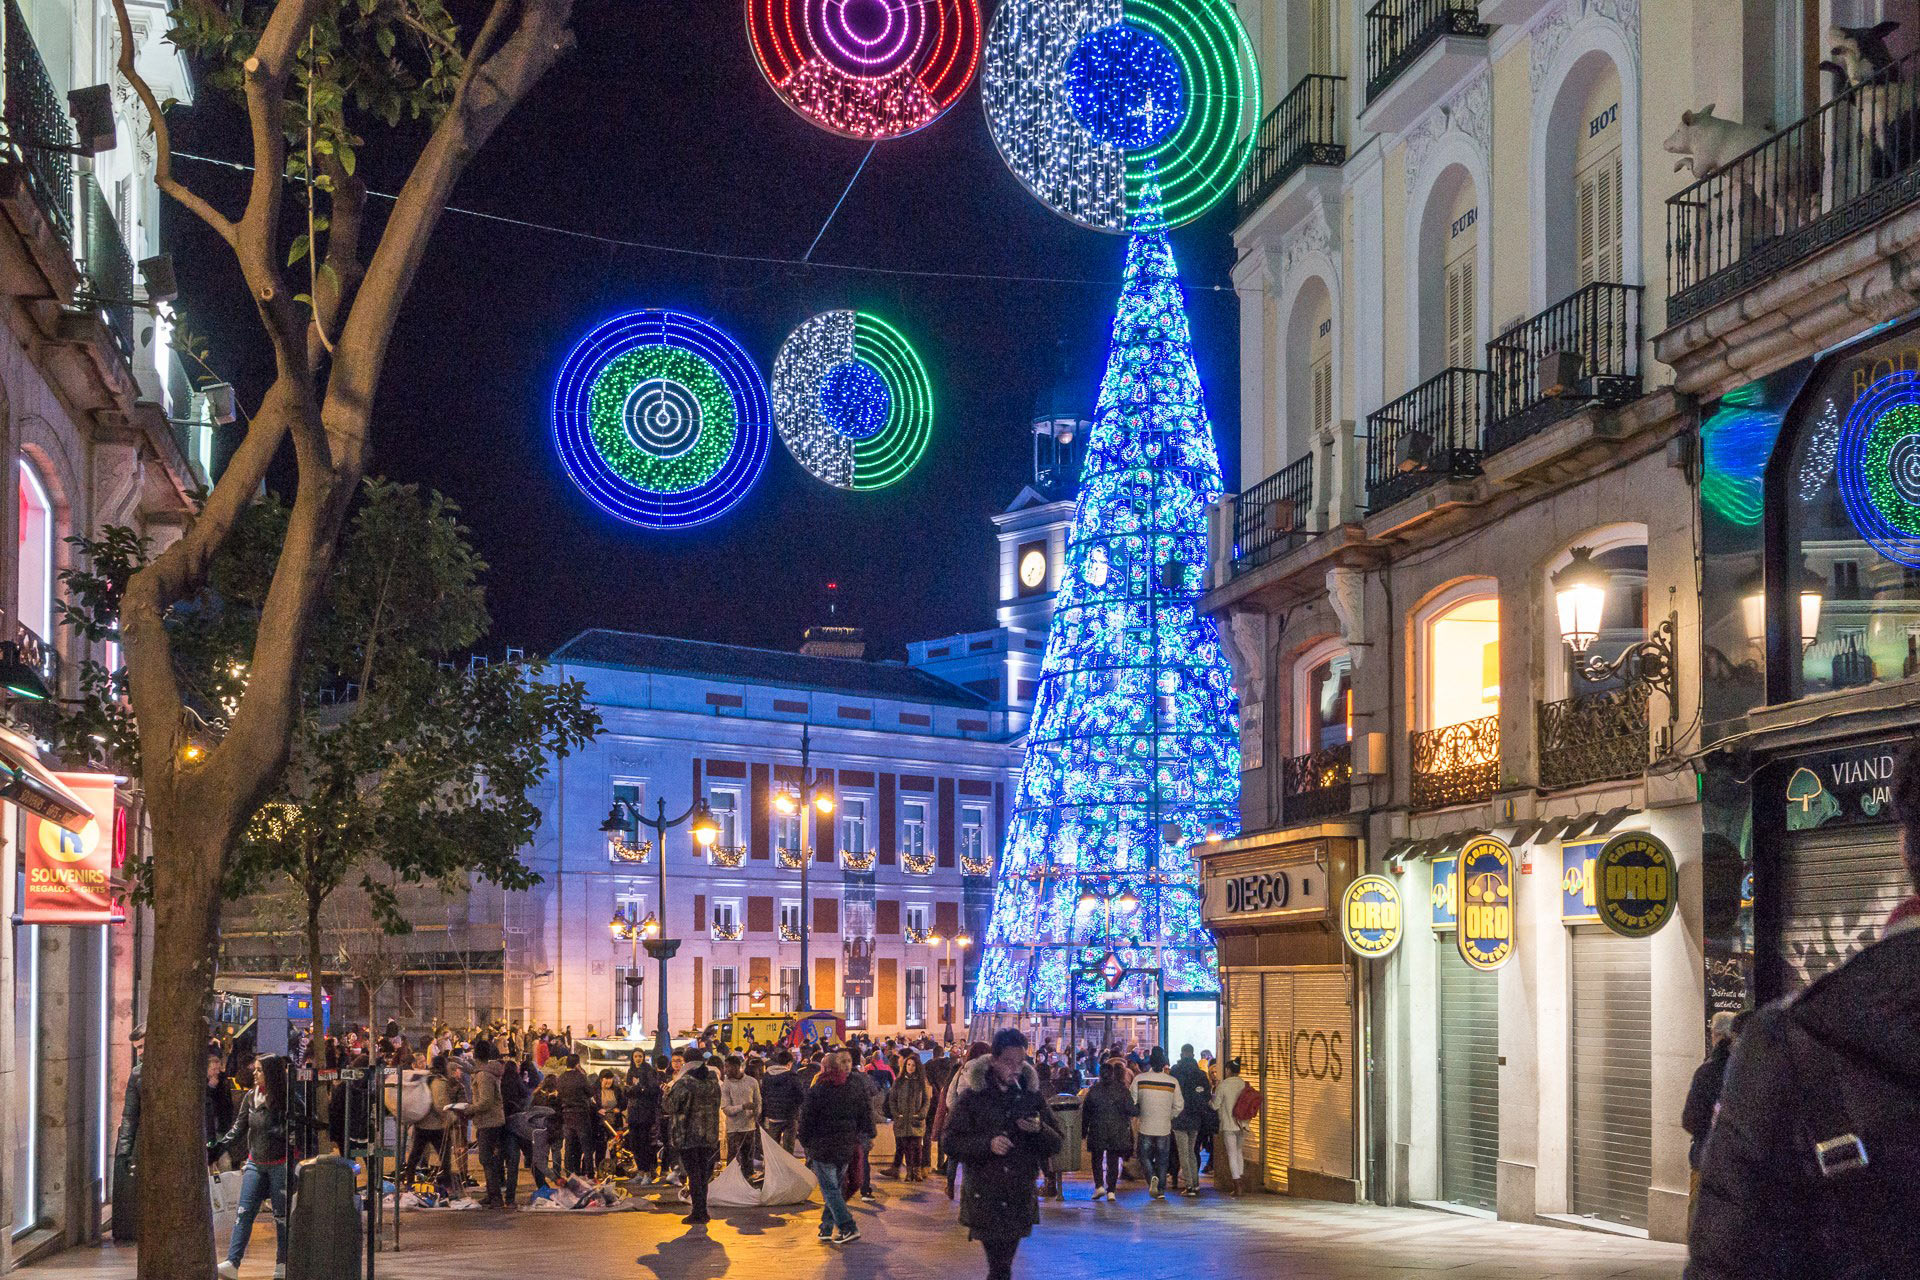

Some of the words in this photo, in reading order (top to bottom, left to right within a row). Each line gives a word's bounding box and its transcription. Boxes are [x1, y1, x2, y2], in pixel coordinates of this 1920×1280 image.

[1590, 103, 1618, 138] HOT
[1832, 756, 1894, 785] VIAND
[1466, 845, 1508, 867] COMPRO
[1608, 841, 1664, 864] COMPRO
[31, 868, 105, 884] SOUVENIRS
[1607, 865, 1667, 900] ORO
[29, 885, 71, 894] REGALOS
[80, 885, 106, 894] GIFTS
[1226, 872, 1290, 913] DIEGO
[1352, 882, 1394, 901] COMPRO
[1349, 901, 1397, 928] ORO
[1466, 905, 1509, 939] ORO
[1607, 903, 1664, 927] EMPEÑO
[1466, 940, 1509, 962] EMPEÑO
